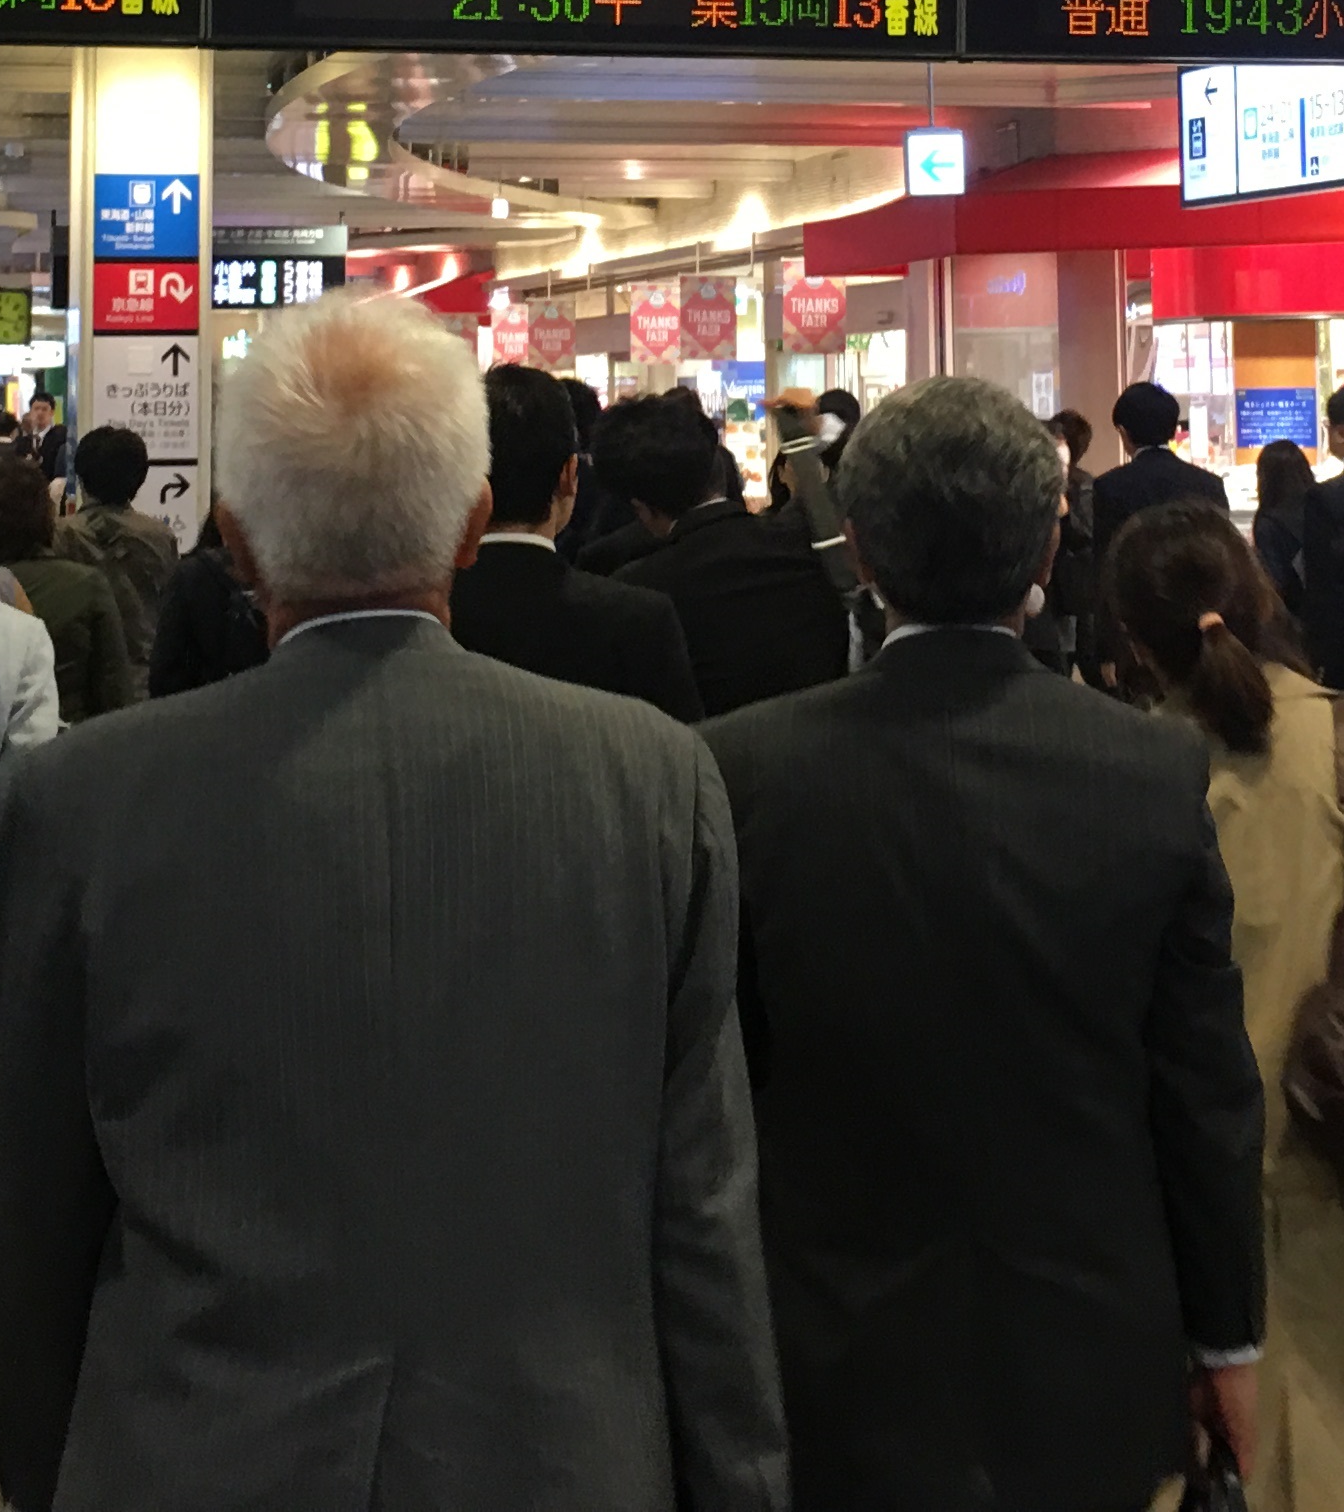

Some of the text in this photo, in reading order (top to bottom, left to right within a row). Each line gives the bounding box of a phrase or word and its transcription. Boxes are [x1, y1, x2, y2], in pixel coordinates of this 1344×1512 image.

[790, 296, 839, 315] THANKS
[637, 315, 679, 331] THANKS
[686, 309, 731, 324] THANKS
[800, 312, 828, 329] FAIR
[645, 328, 669, 343] FAIR
[697, 323, 721, 337] FAIR
[106, 382, 191, 399] きっぷうりば
[130, 400, 191, 417] (本日分)
